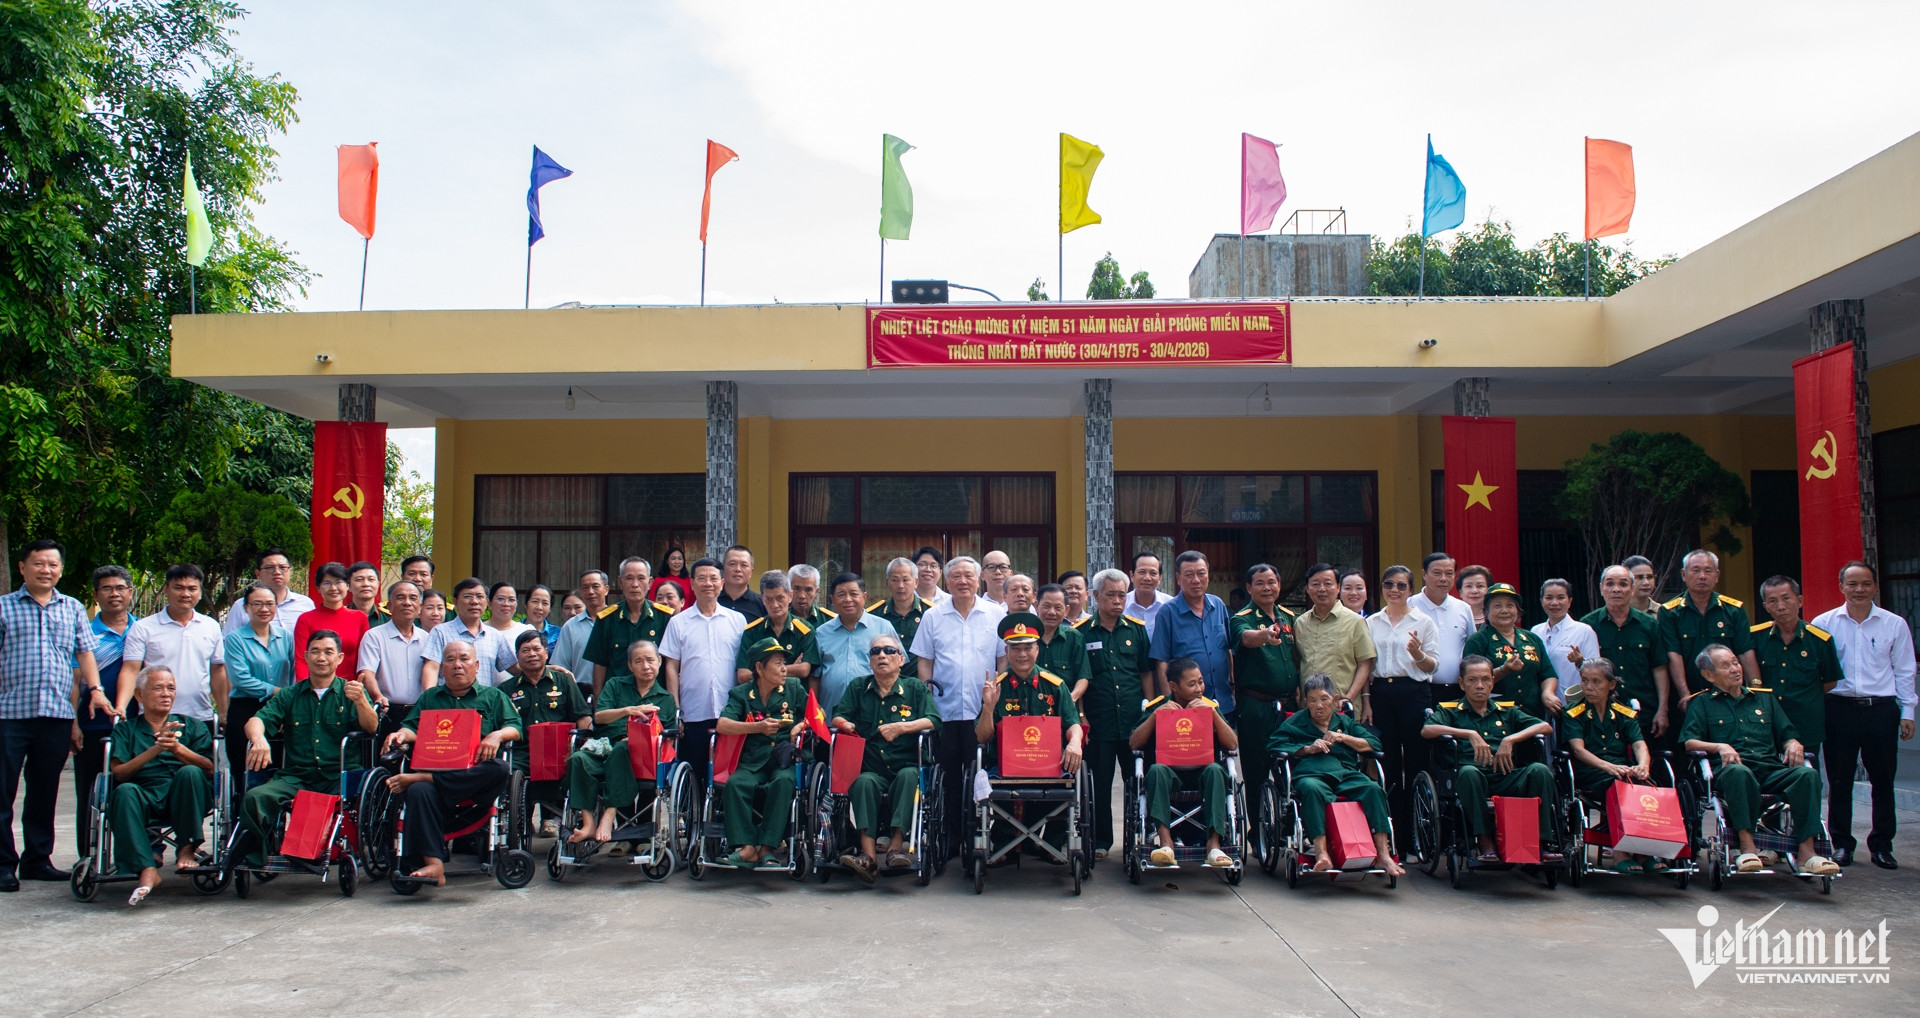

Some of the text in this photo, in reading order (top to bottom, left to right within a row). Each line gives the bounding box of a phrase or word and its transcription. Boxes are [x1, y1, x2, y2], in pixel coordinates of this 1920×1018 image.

[880, 311, 1273, 338] NHIỆT LIỆT CHÀO MỪNG KỶ NIỆM 51 NĂM NGÀY GIẢI PHÓNG MIỀN NAM,
[947, 339, 985, 360] THỐNG
[988, 339, 1018, 360] NHẤT
[1020, 338, 1042, 359] ĐẤT
[1045, 340, 1077, 359] NƯỚC
[1080, 342, 1140, 360] (30/4/1975
[1150, 341, 1210, 359] 30/4/2026)
